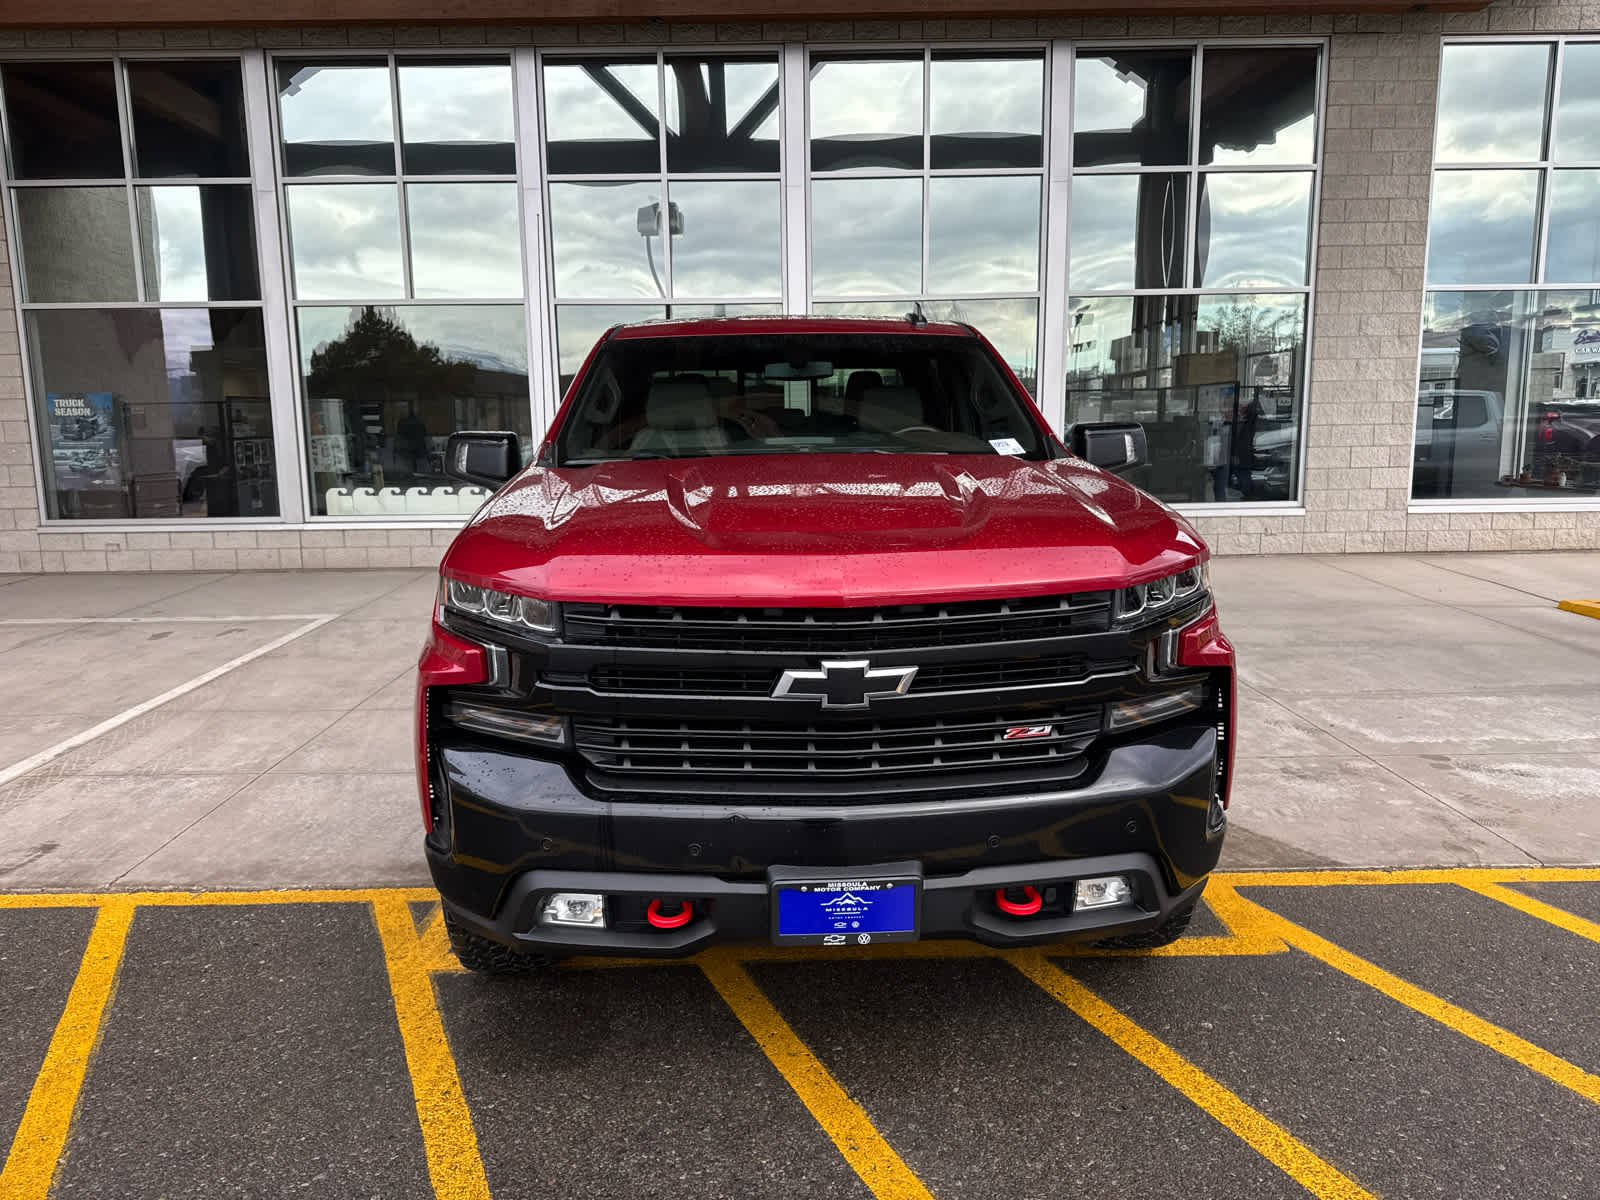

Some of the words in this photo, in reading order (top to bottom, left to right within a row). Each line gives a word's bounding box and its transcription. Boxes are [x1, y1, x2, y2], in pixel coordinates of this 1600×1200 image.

[53, 399, 85, 407] TRUCK
[54, 407, 90, 416] SEASON
[1003, 725, 1052, 739] Z71
